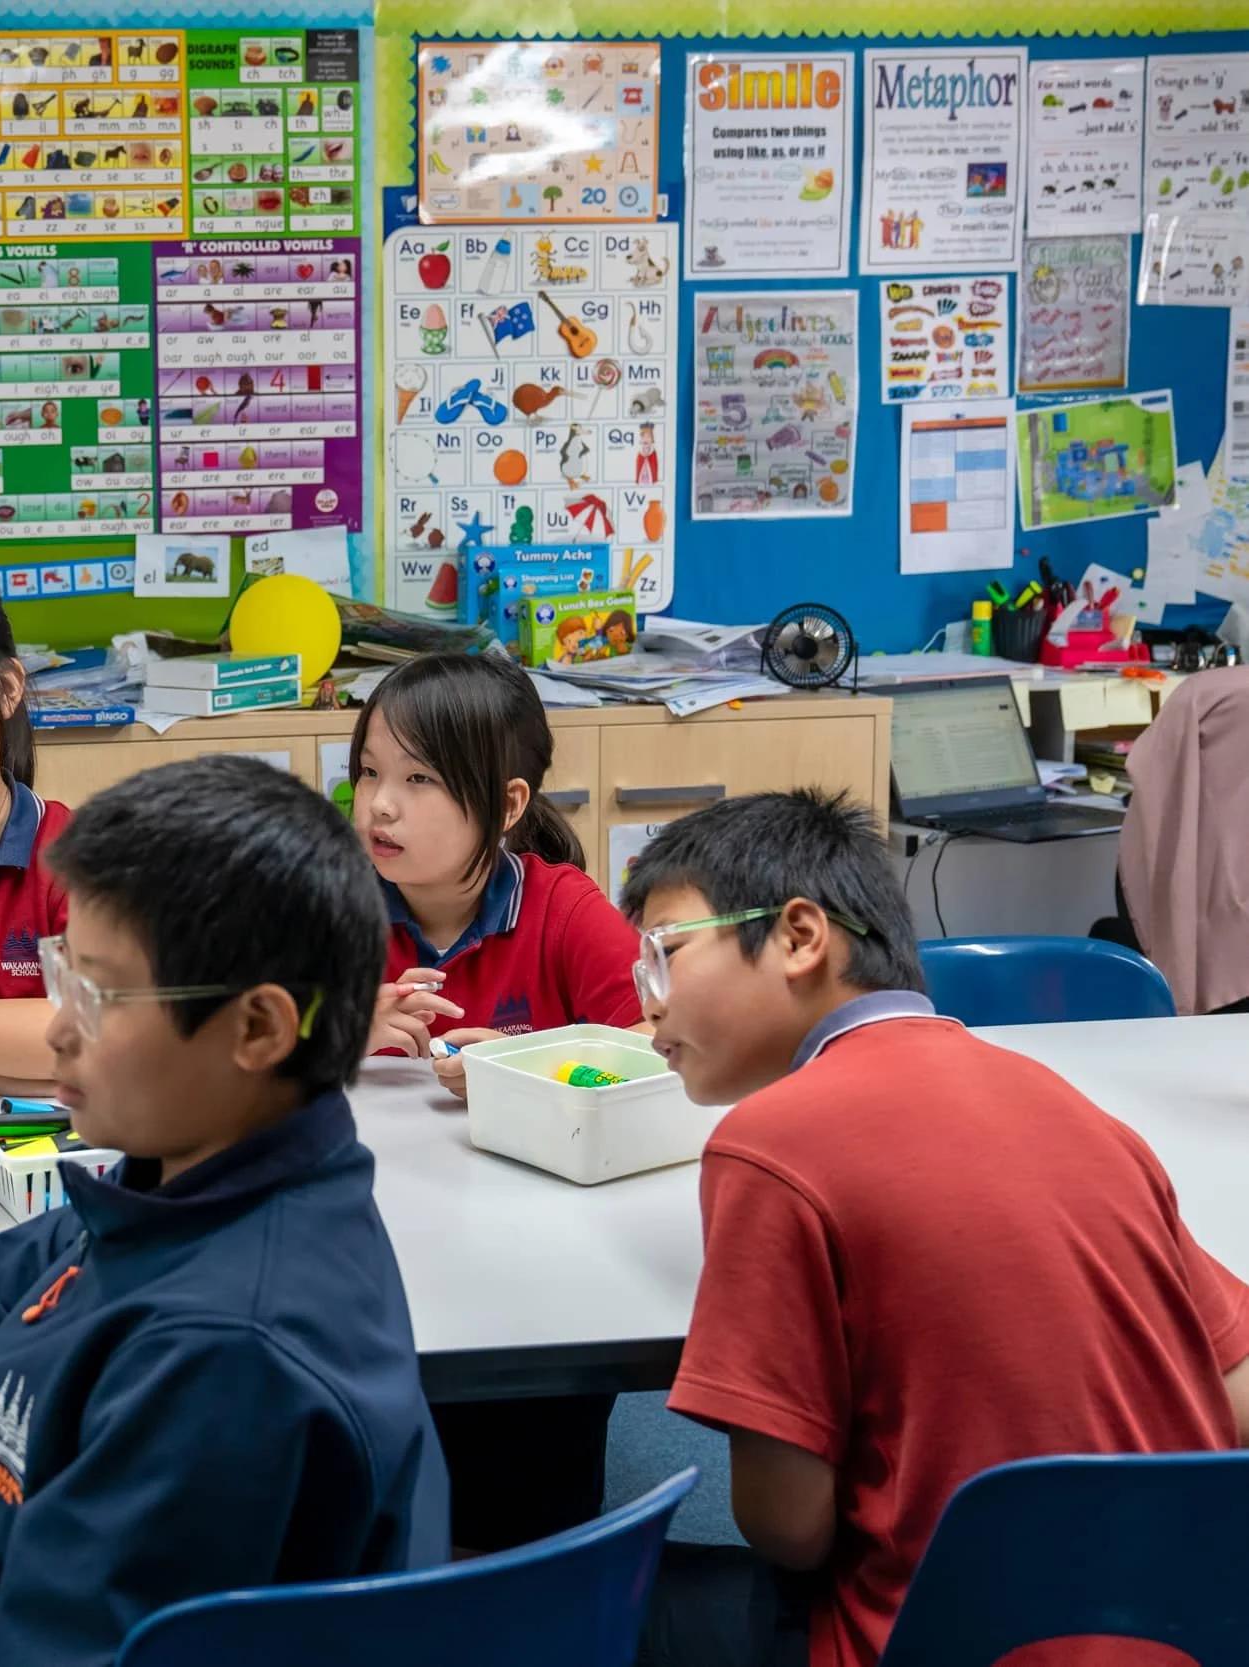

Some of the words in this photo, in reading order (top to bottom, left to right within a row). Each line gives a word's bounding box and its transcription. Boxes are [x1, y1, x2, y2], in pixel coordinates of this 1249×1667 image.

[187, 44, 237, 54] DIGRAPH
[189, 59, 235, 70] SOUNDS
[247, 68, 260, 79] ch
[279, 68, 296, 79] tch
[699, 61, 840, 110] Simile
[874, 56, 1017, 121] Metaphor
[1038, 81, 1053, 89] For
[1057, 80, 1080, 89] most
[1084, 78, 1112, 88] words
[1155, 77, 1189, 90] Change
[1193, 75, 1209, 85] the
[128, 120, 146, 130] mb
[198, 120, 210, 130] sh
[264, 119, 277, 130] ch
[296, 120, 308, 130] th
[1108, 121, 1124, 132] add
[1201, 122, 1218, 132] add
[713, 127, 767, 139] Compares
[771, 128, 790, 137] two
[793, 126, 826, 138] things
[714, 148, 744, 159] using
[789, 148, 800, 157] or
[803, 147, 814, 157] as
[818, 145, 825, 156] if
[1152, 159, 1182, 170] Change
[1187, 156, 1200, 167] the
[329, 167, 347, 178] the
[582, 188, 606, 204] 20
[200, 220, 213, 232] ng
[256, 218, 283, 231] ngue
[6, 245, 57, 257] VOWELS
[200, 241, 281, 253] CONTROLLED
[284, 239, 333, 251] VOWELS
[400, 240, 424, 254] Aa
[466, 239, 487, 253] Bb
[564, 237, 589, 252] Cc
[606, 237, 629, 251] Dd
[401, 305, 420, 319] Ee
[461, 304, 473, 318] Ff
[582, 301, 608, 320] Gg
[640, 301, 661, 314] Hh
[492, 369, 503, 384] Jj
[541, 368, 560, 381] Kk
[629, 365, 660, 379] Mm
[438, 434, 460, 447] Nn
[477, 432, 502, 446] Oo
[536, 431, 556, 447] Pp
[609, 429, 634, 445] Qq
[401, 498, 416, 512] Rr
[452, 497, 468, 511] Ss
[503, 496, 515, 508] Tt
[624, 492, 645, 506] Vv
[547, 512, 568, 527] Uu
[252, 538, 269, 552] ed
[515, 550, 559, 562] Tummy
[563, 550, 591, 560] Ache
[402, 562, 432, 576] Ww
[143, 570, 156, 583] el
[521, 574, 558, 583] Shopping
[561, 573, 574, 581] List
[640, 578, 656, 591] Zz
[558, 602, 585, 612] Lunch
[588, 600, 604, 610] Box
[1, 961, 42, 972] WAKAARAN
[11, 969, 40, 977] SCHOOL
